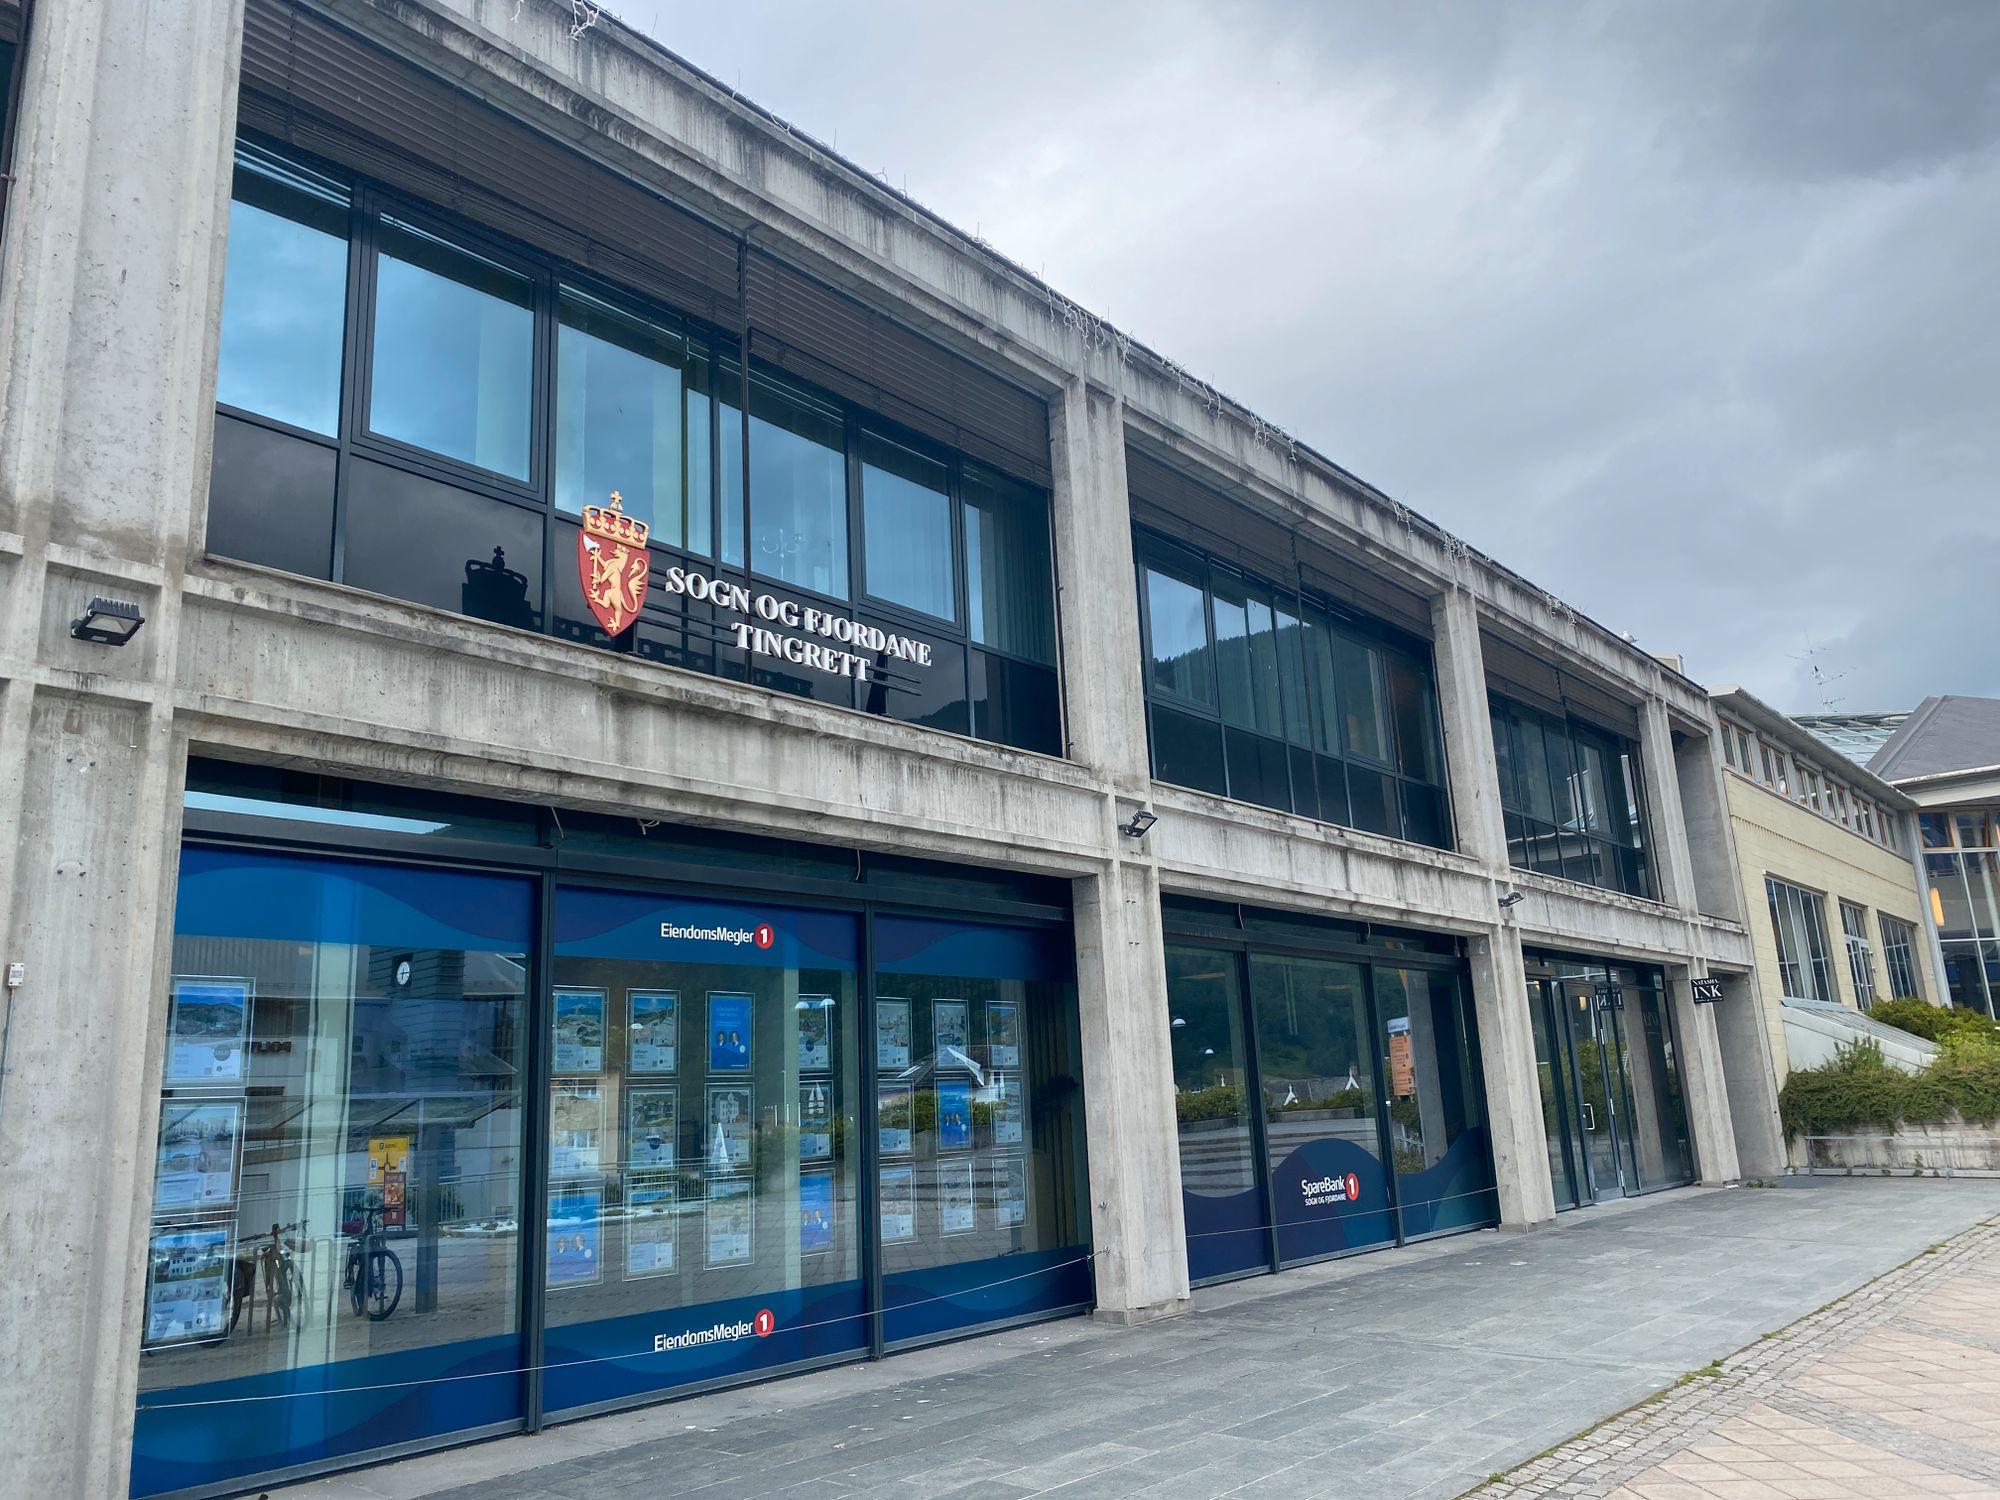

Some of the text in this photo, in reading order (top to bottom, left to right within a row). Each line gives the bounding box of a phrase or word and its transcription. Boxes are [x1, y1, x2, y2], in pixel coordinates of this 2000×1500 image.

[665, 566, 932, 667] SOGN OG FJORDANE
[731, 622, 870, 682] TINGRETT
[660, 922, 754, 946] EiendomsMegler
[1694, 984, 1723, 999] INK
[1301, 1175, 1346, 1198] SpareBank
[1305, 1193, 1347, 1206] SOGN OG FJORDANE
[654, 1320, 753, 1353] EiendomsMegler
